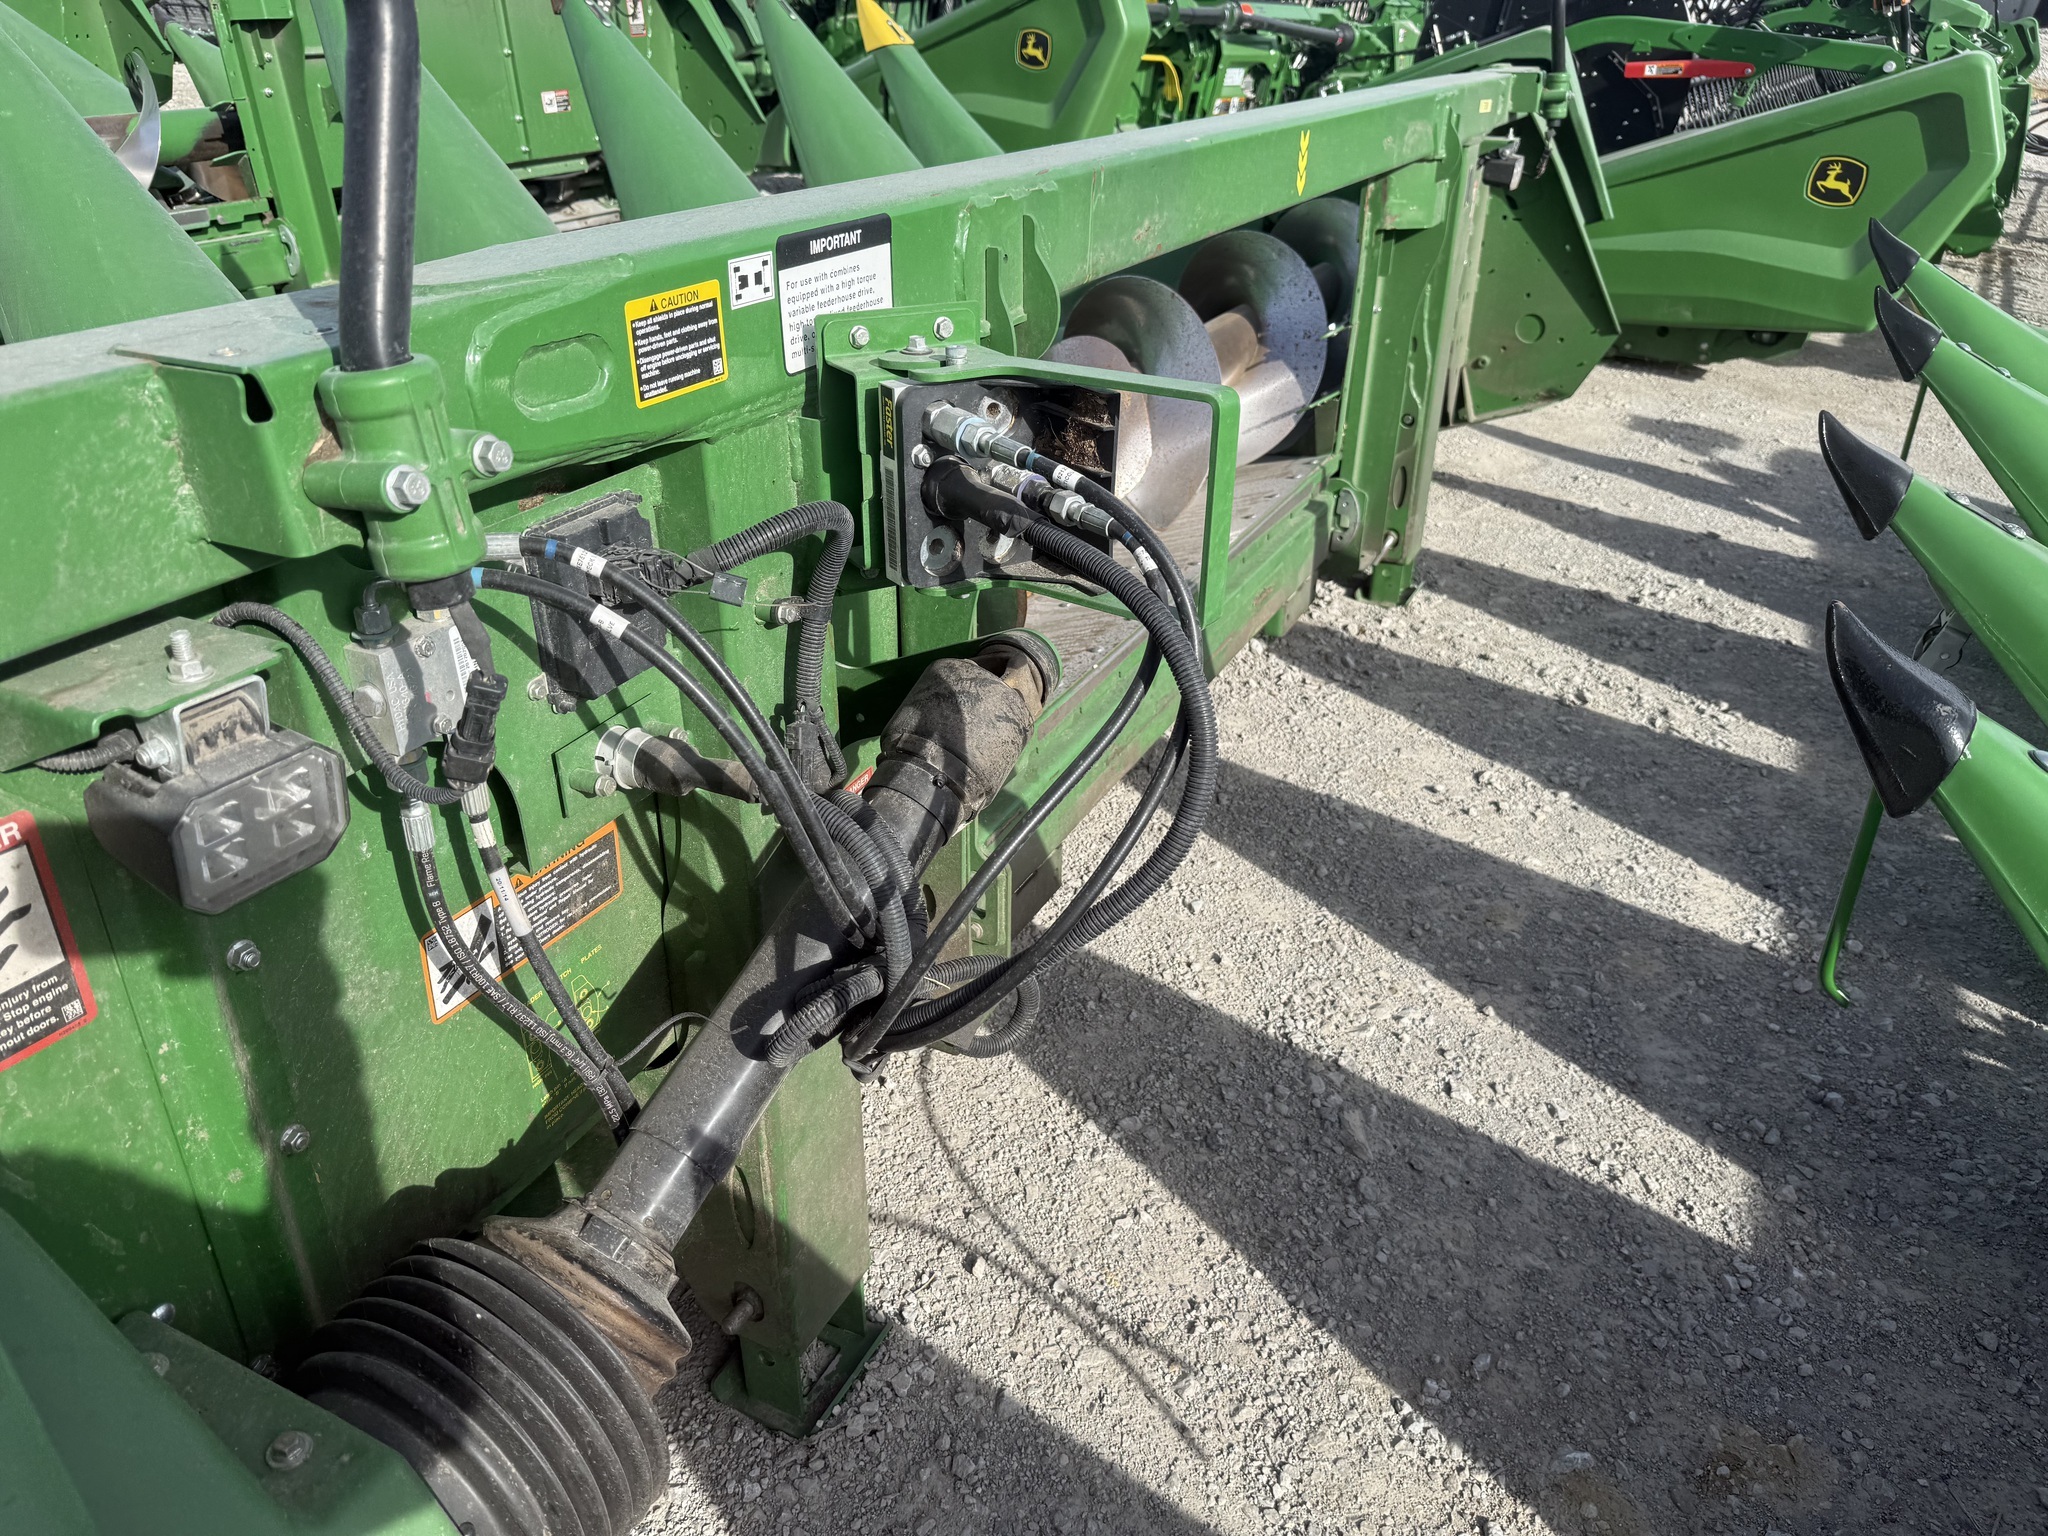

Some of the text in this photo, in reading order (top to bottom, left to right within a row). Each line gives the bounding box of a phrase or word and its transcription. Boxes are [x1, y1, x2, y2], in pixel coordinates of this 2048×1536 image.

[810, 229, 862, 255] IMPORTANT
[786, 264, 860, 290] For use with combines
[787, 288, 818, 305] equipped
[820, 284, 834, 295] with
[841, 279, 855, 290] high
[857, 272, 877, 285] torque
[661, 290, 699, 309] CAUTION
[788, 303, 816, 318] variable
[817, 291, 856, 310] feederhouse
[635, 320, 646, 328] Keep
[653, 313, 668, 323] shields
[674, 309, 685, 318] place
[686, 305, 699, 314] during
[699, 301, 713, 310] normal
[789, 318, 814, 332] high-to
[636, 325, 660, 336] operations.
[637, 337, 648, 346] Keep
[681, 324, 697, 334] clothing
[698, 320, 708, 329] away
[709, 318, 717, 326] from
[638, 337, 678, 355] power-driven parts.
[640, 353, 661, 365] Disengage
[662, 345, 688, 358] power-driven
[689, 341, 699, 351] parts
[707, 336, 716, 344] shut
[792, 345, 814, 359] multi-s
[647, 361, 661, 371] engine
[662, 356, 675, 365] before
[675, 349, 697, 361] unclogging
[702, 343, 720, 353] servicing
[641, 370, 660, 380] machine.
[657, 379, 668, 387] leave
[669, 373, 684, 384] running
[684, 368, 700, 378] machine
[644, 386, 668, 399] unattended.
[884, 396, 894, 449] Faster
[386, 672, 398, 694] USA
[390, 697, 406, 732] HYDAC
[850, 774, 870, 793] NGER
[425, 864, 436, 888] Flame
[436, 908, 448, 926] Type
[441, 924, 459, 948] 18752
[454, 947, 467, 961] ISO
[581, 945, 602, 964] PLATES
[465, 963, 490, 990] 100R17
[0, 976, 58, 1010] njury from
[3, 983, 69, 1021] Stop engine
[485, 986, 501, 1001] SAE
[0, 1026, 13, 1038] ey
[16, 1006, 52, 1028] before
[27, 1016, 59, 1036] doors.
[535, 1026, 549, 1039] ISO
[604, 1094, 614, 1110] MPa
[609, 1108, 620, 1123] 22.5
